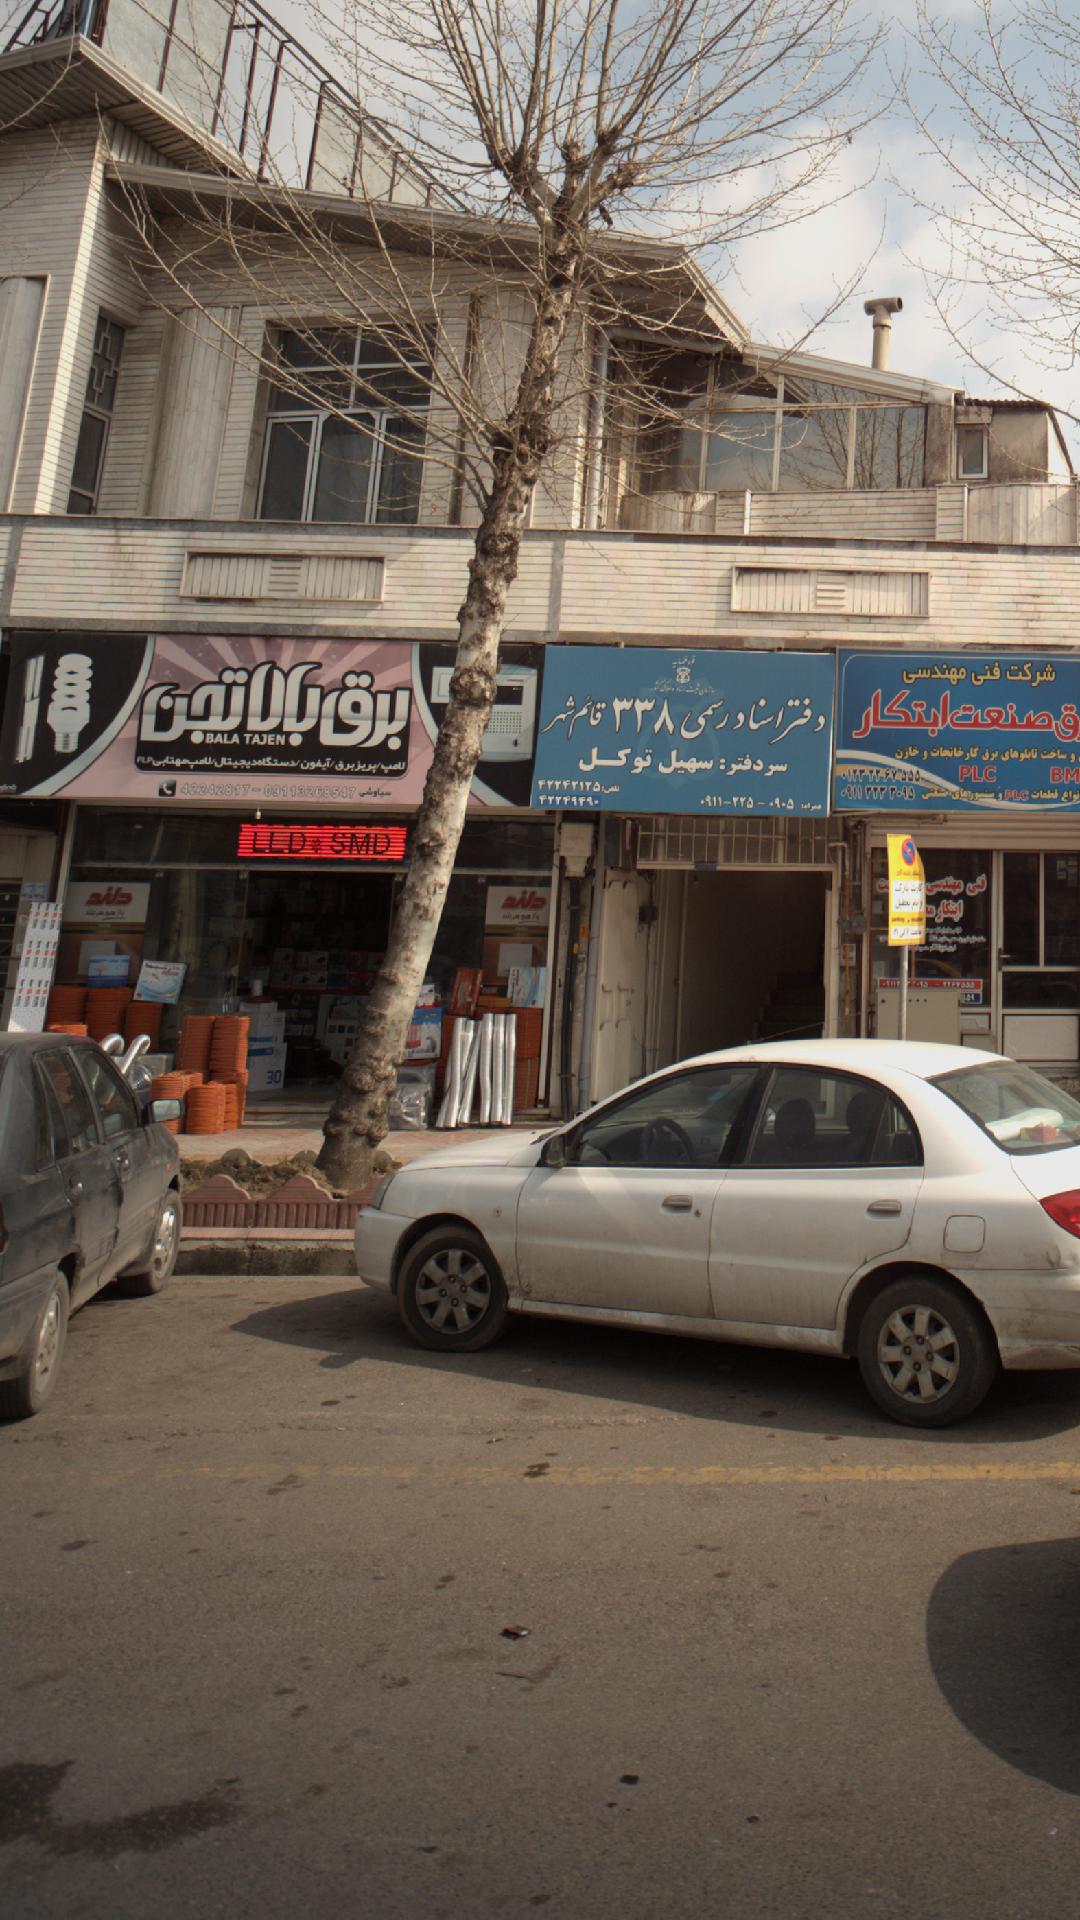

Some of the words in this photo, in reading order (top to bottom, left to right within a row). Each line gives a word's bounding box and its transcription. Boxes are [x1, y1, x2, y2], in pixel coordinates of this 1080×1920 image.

[903, 663, 967, 685] مهندسی
[971, 661, 1001, 685] فنی
[1006, 662, 1056, 686] شرکت
[320, 671, 409, 750] برق
[612, 697, 676, 735] ۳۳۸
[680, 697, 728, 739] رسمی
[732, 697, 785, 731] اسناد
[769, 697, 827, 744] دفتر
[852, 688, 950, 738] ابتکار
[950, 703, 1054, 729] صنعت
[206, 734, 240, 746] BALA
[244, 734, 287, 747] TAJEN
[578, 747, 654, 774] توکل
[658, 750, 714, 774] سهیل
[982, 749, 999, 761] برق
[1001, 748, 1038, 762] تابلوهای
[1040, 749, 1067, 760] ساخت
[959, 765, 997, 782] PLC
[1005, 789, 1029, 801] PLC
[331, 832, 391, 855] SMD
